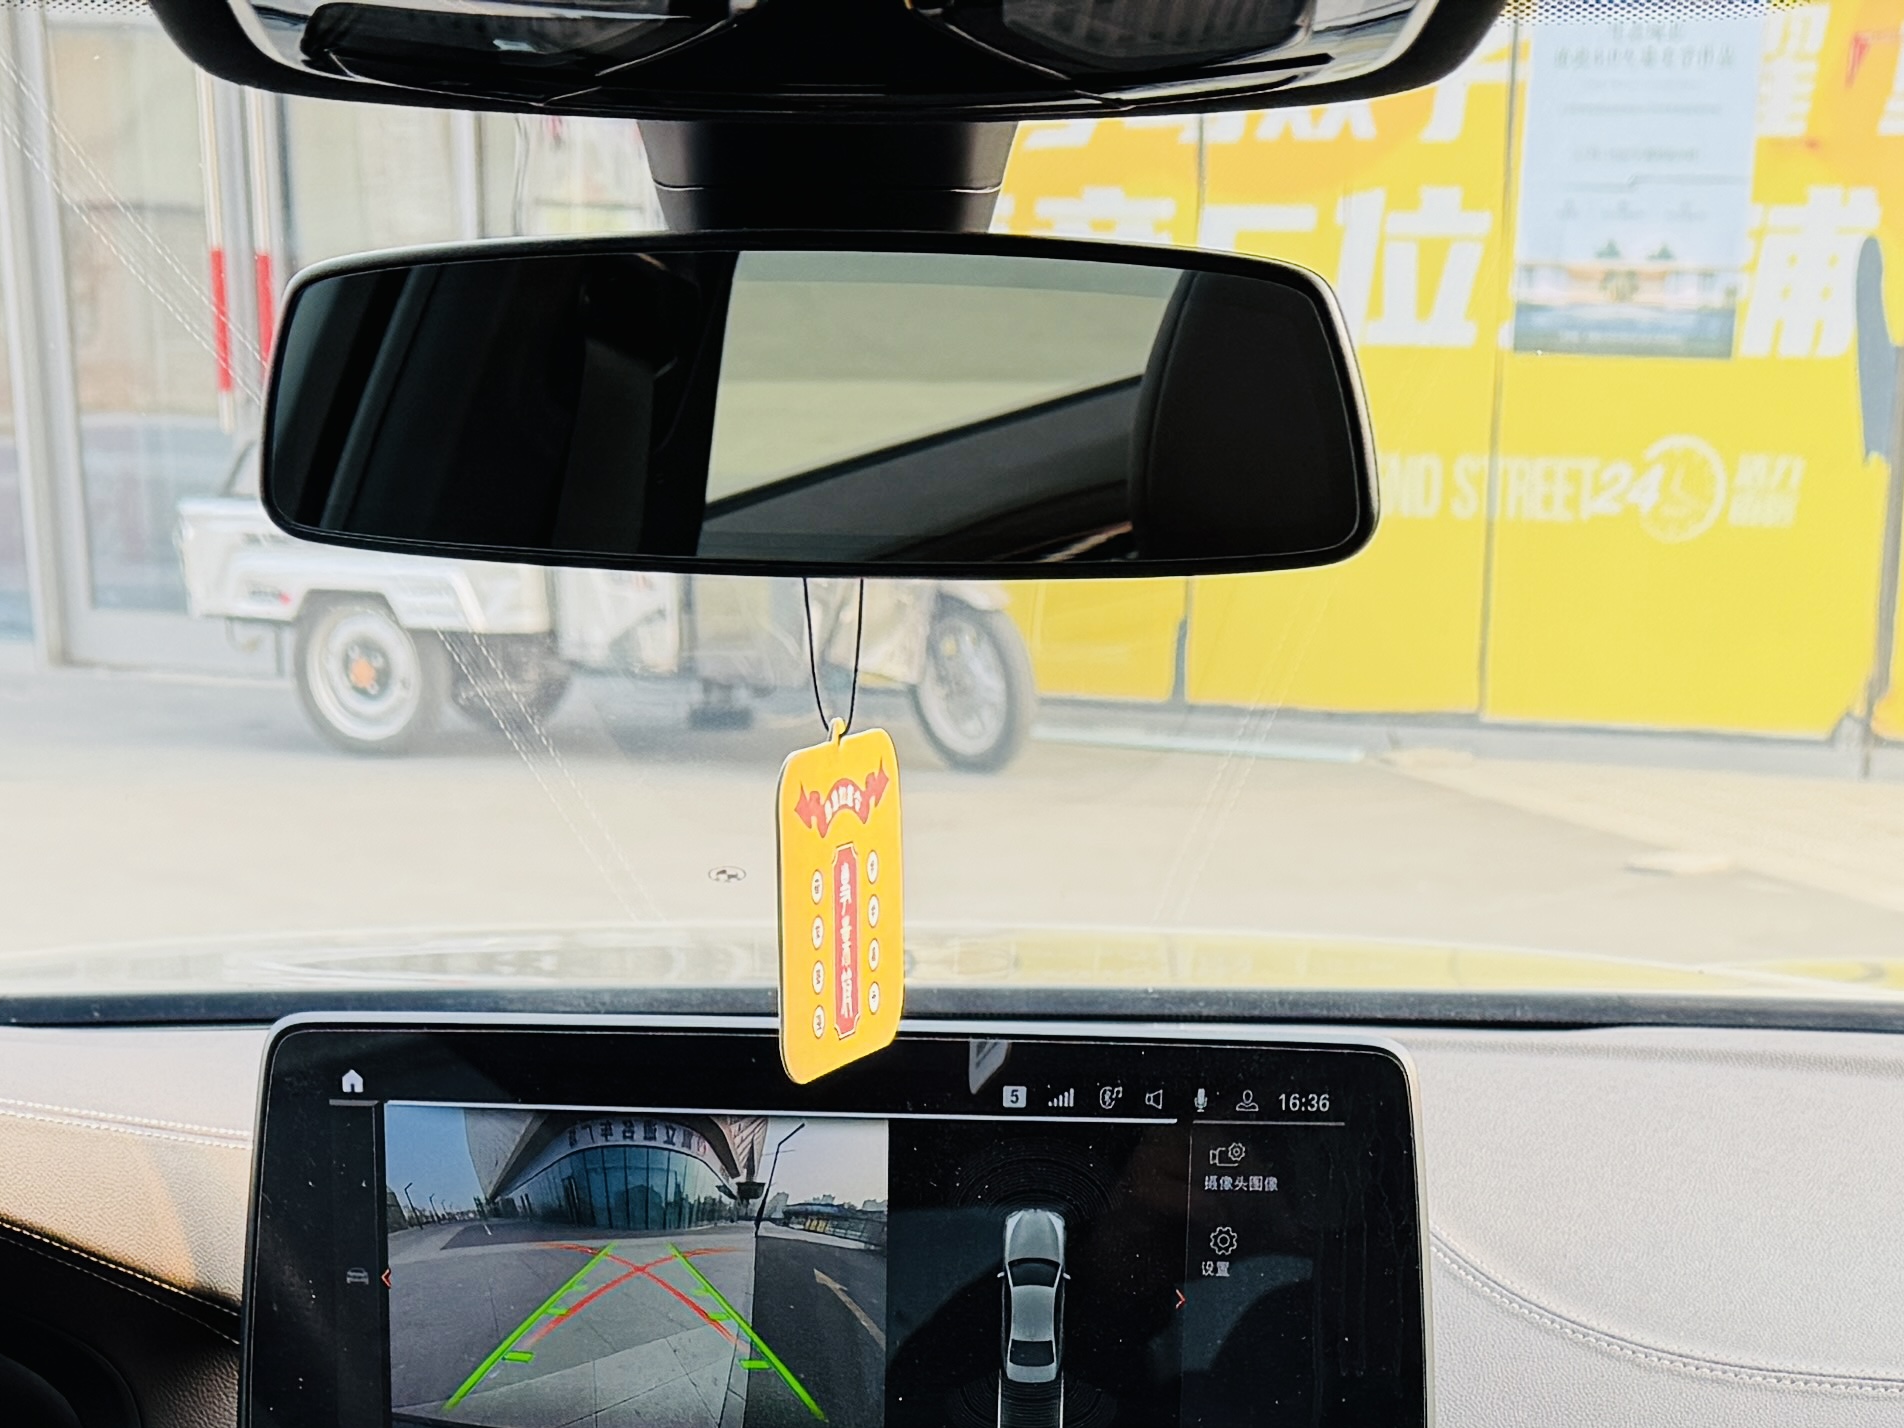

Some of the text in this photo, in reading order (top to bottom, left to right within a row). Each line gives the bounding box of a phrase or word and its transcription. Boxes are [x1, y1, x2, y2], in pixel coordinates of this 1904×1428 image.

[1278, 1093, 1330, 1111] 16:36
[1204, 1176, 1278, 1192] 摄像头图像
[1202, 1261, 1230, 1277] 设置
